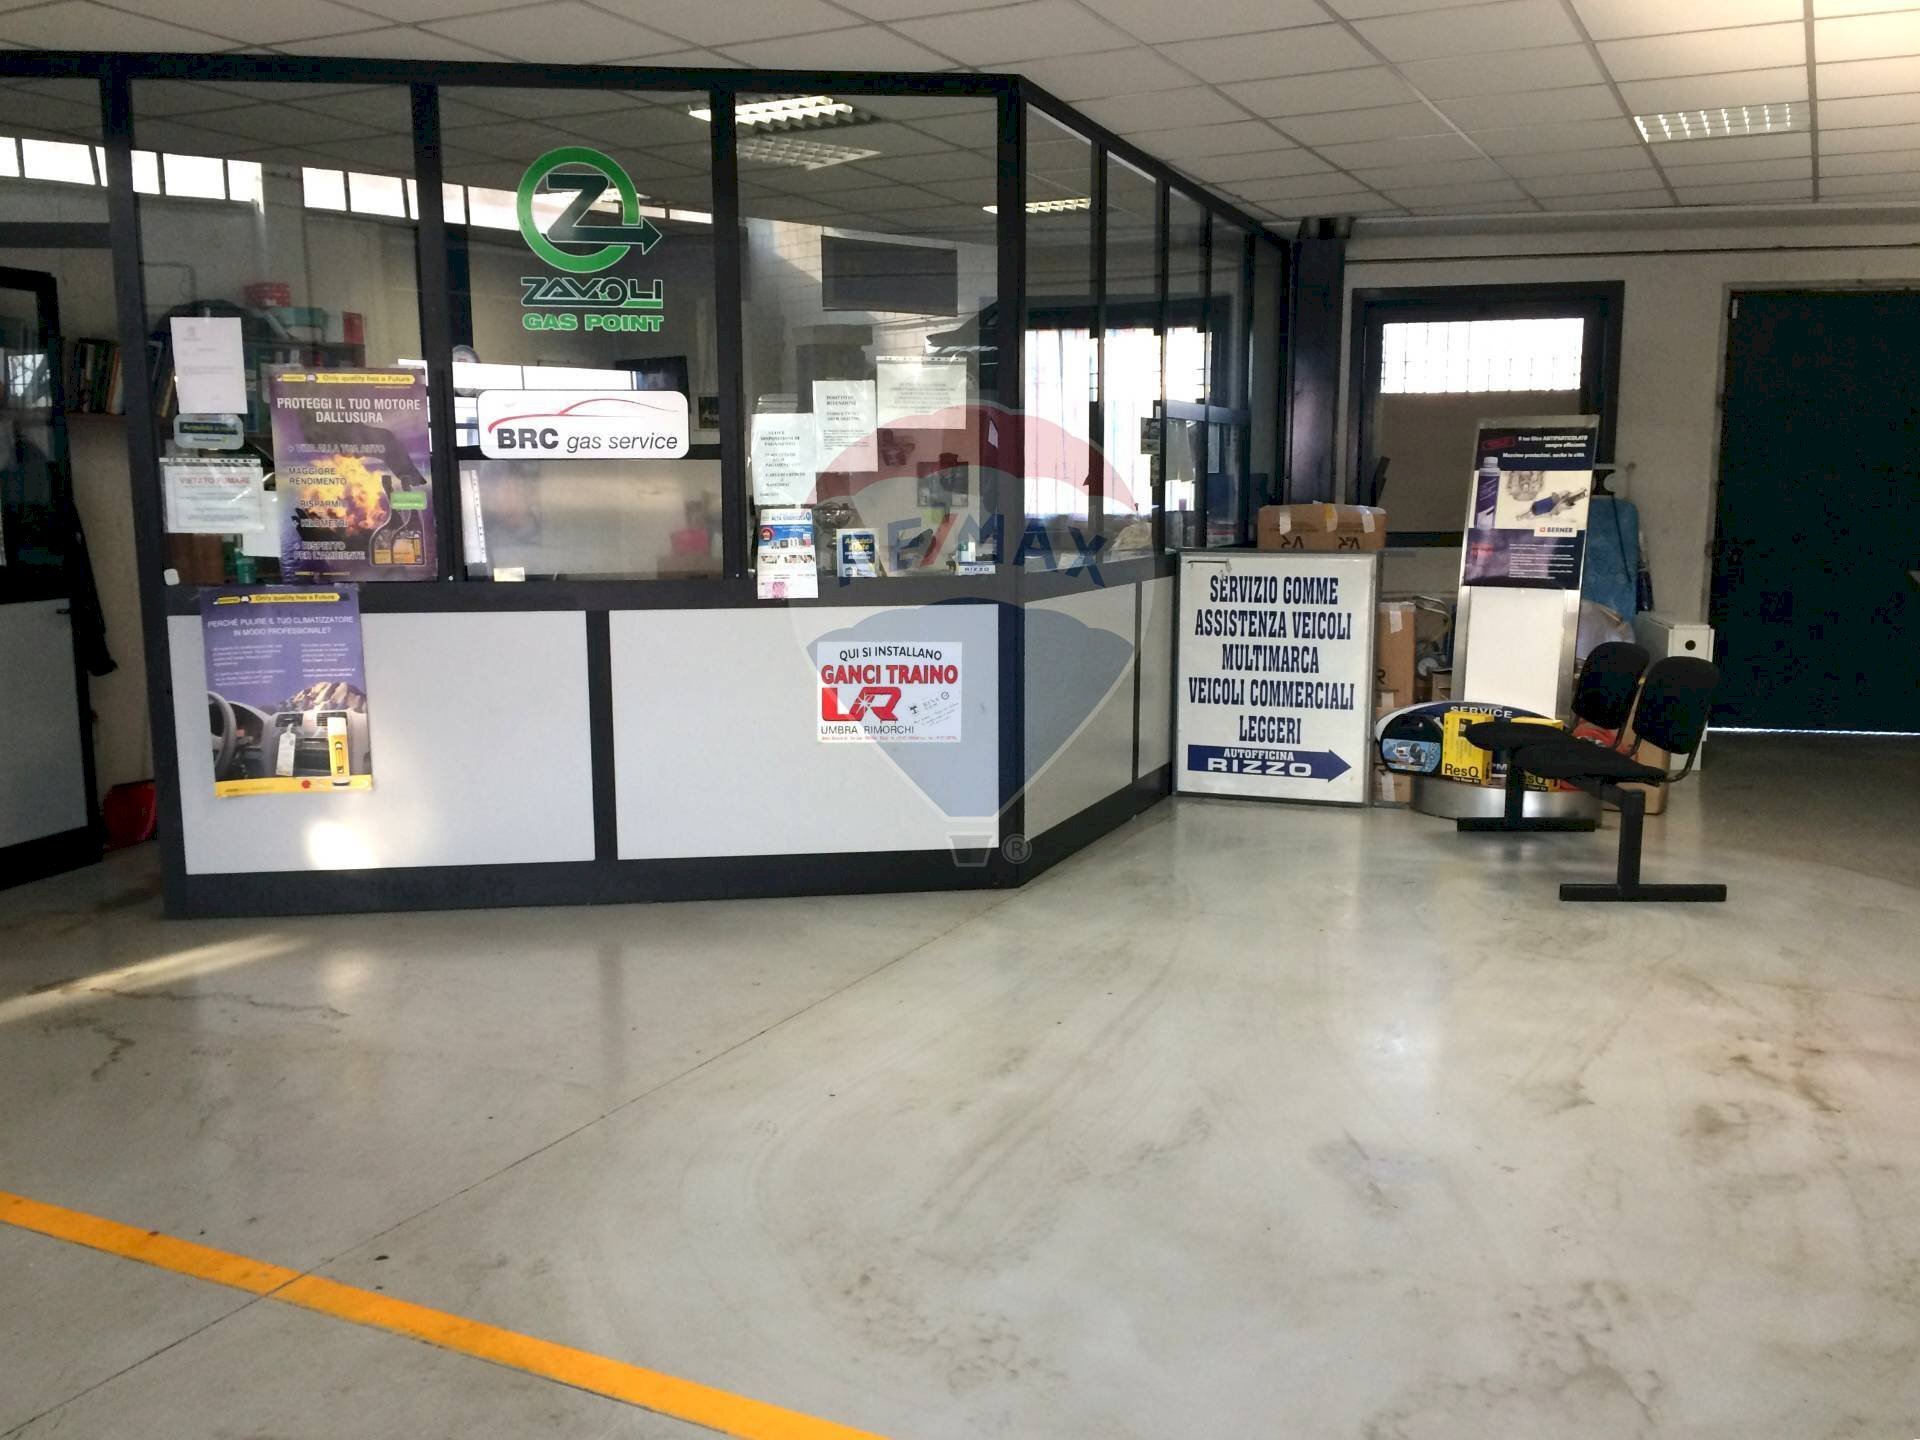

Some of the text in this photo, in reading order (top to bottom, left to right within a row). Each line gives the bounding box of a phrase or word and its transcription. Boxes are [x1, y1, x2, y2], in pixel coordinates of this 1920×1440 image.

[521, 277, 663, 309] ZAVOLI
[523, 313, 664, 332] GAS POINT
[277, 397, 421, 411] PROTEGGI IL TUO MOTORE
[316, 411, 384, 423] DALL'USURA
[497, 428, 678, 454] BRC gas service
[288, 467, 336, 475] MAGGIORE
[289, 477, 347, 485] RENDIMENTO
[1210, 575, 1339, 605] SERVIZIO GOMME
[1194, 609, 1352, 640] ASSISTENZA VEICOLI
[839, 646, 942, 661] QUI SI INSTALLANO
[1222, 643, 1319, 674] MULTIMARCA
[821, 664, 959, 685] GANCI TRAINO
[1188, 677, 1355, 710] VEICOLI COMMERCIALI
[821, 725, 914, 735] UMBRA RIMORCHI
[1239, 715, 1302, 744] LEGGERI
[1223, 748, 1295, 761] AUTOFFICINA
[1207, 758, 1312, 777] RIZZO
[1444, 763, 1480, 777] ResQ
